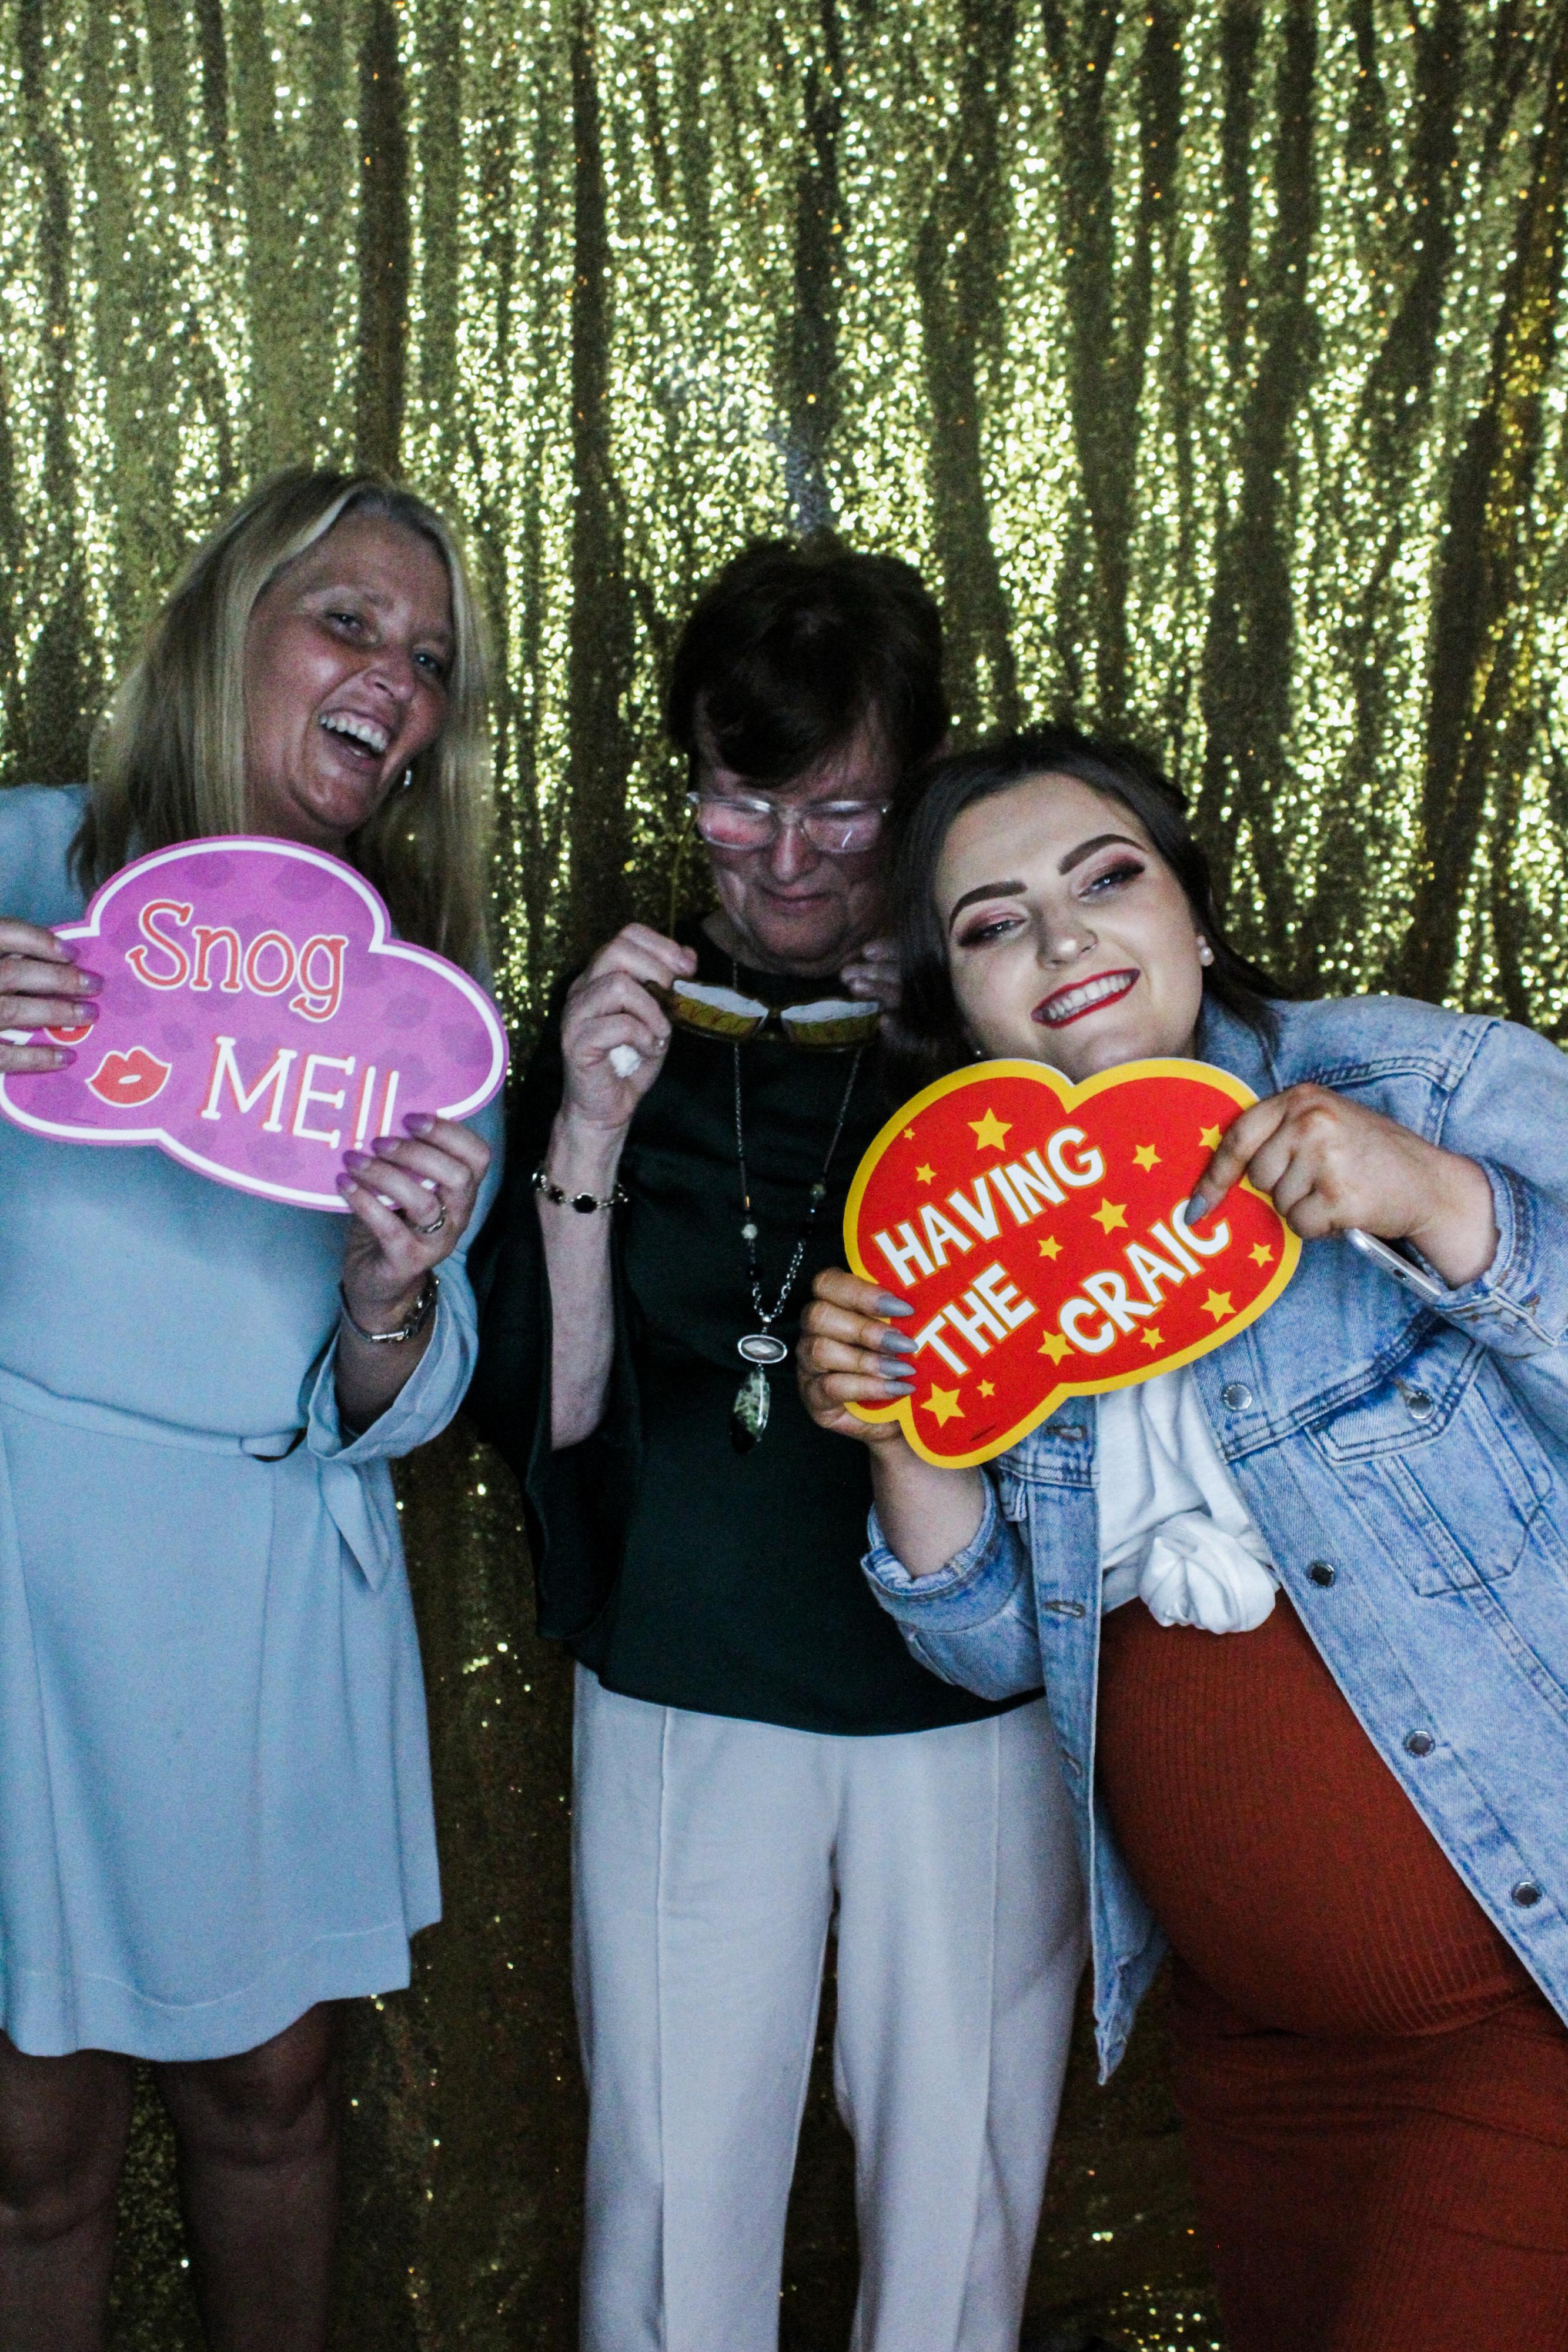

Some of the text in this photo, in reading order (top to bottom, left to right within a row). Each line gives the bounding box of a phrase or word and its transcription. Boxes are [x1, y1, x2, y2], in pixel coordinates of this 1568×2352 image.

[126, 901, 346, 1021] Snog
[874, 1127, 1105, 1287] HAVING
[914, 1199, 1230, 1376] THE CRAIC
